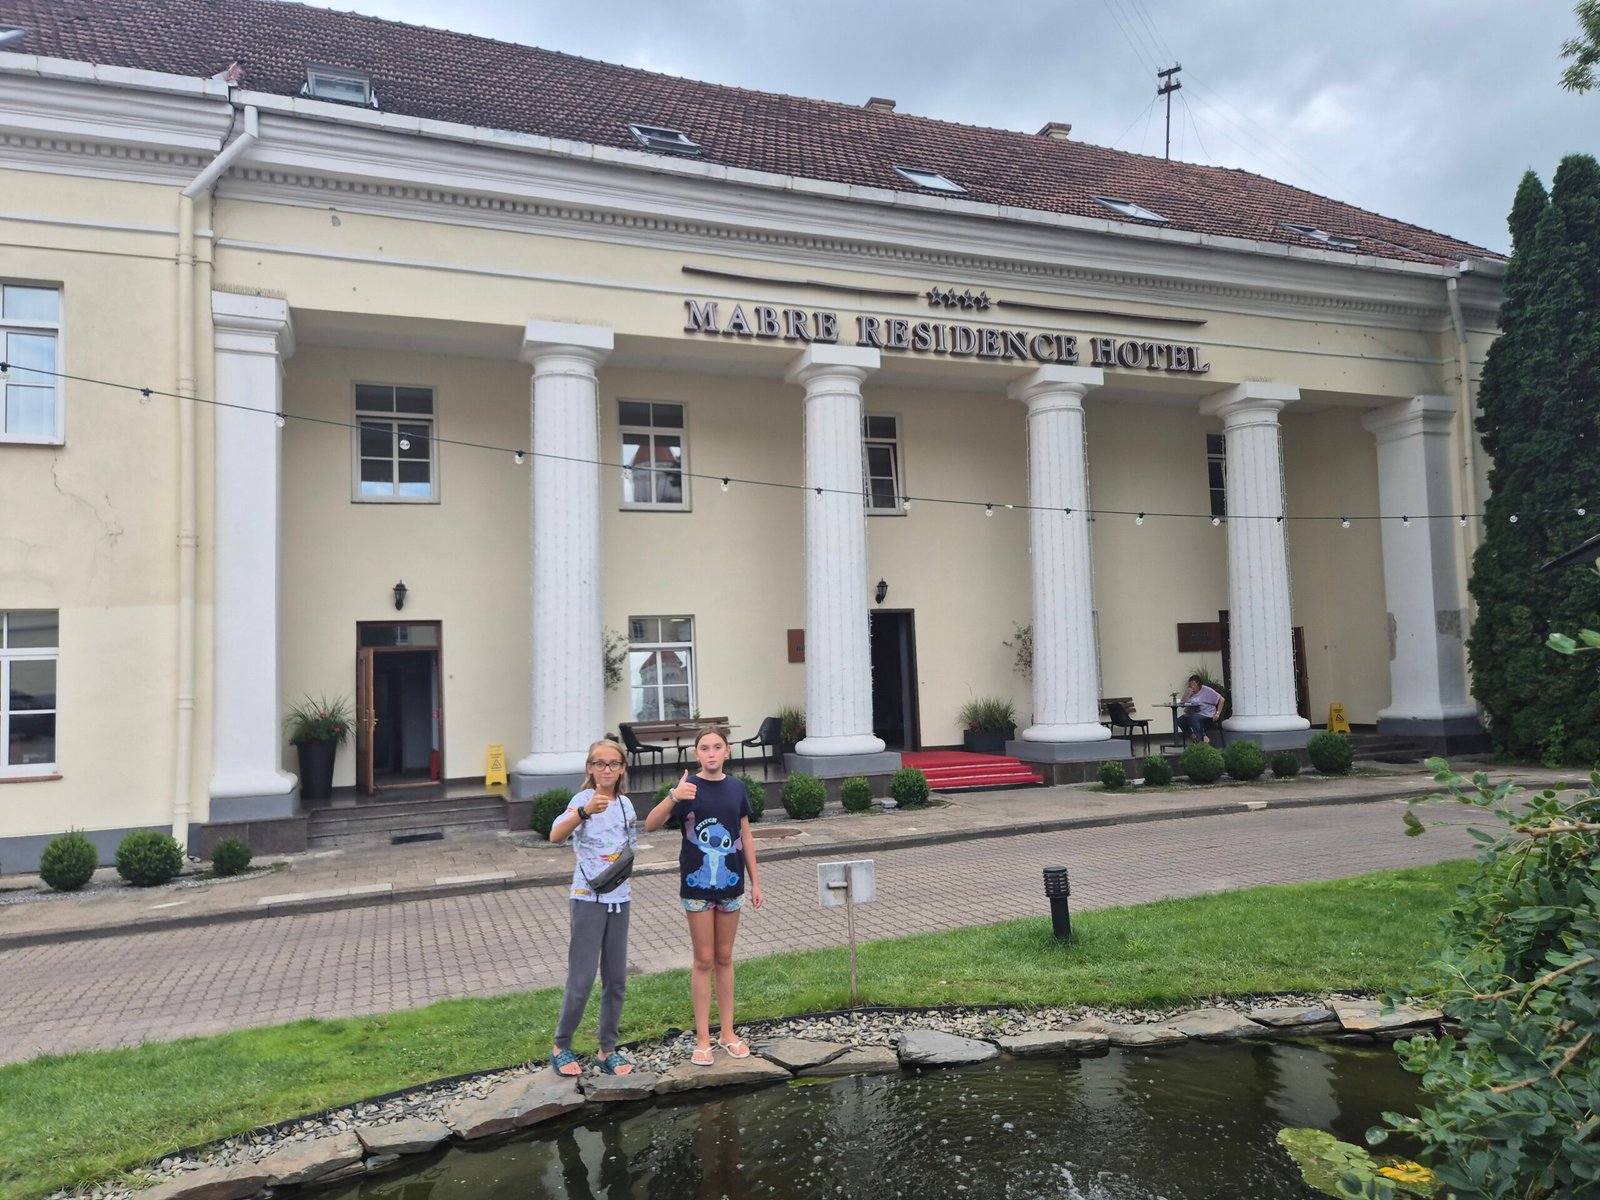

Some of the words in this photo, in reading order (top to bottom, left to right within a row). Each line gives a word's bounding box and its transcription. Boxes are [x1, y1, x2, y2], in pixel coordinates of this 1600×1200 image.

[684, 300, 839, 343] MABRE
[856, 315, 1079, 364] RESIDENCE
[1090, 337, 1210, 373] HOTEL
[695, 817, 717, 830] STITCH
